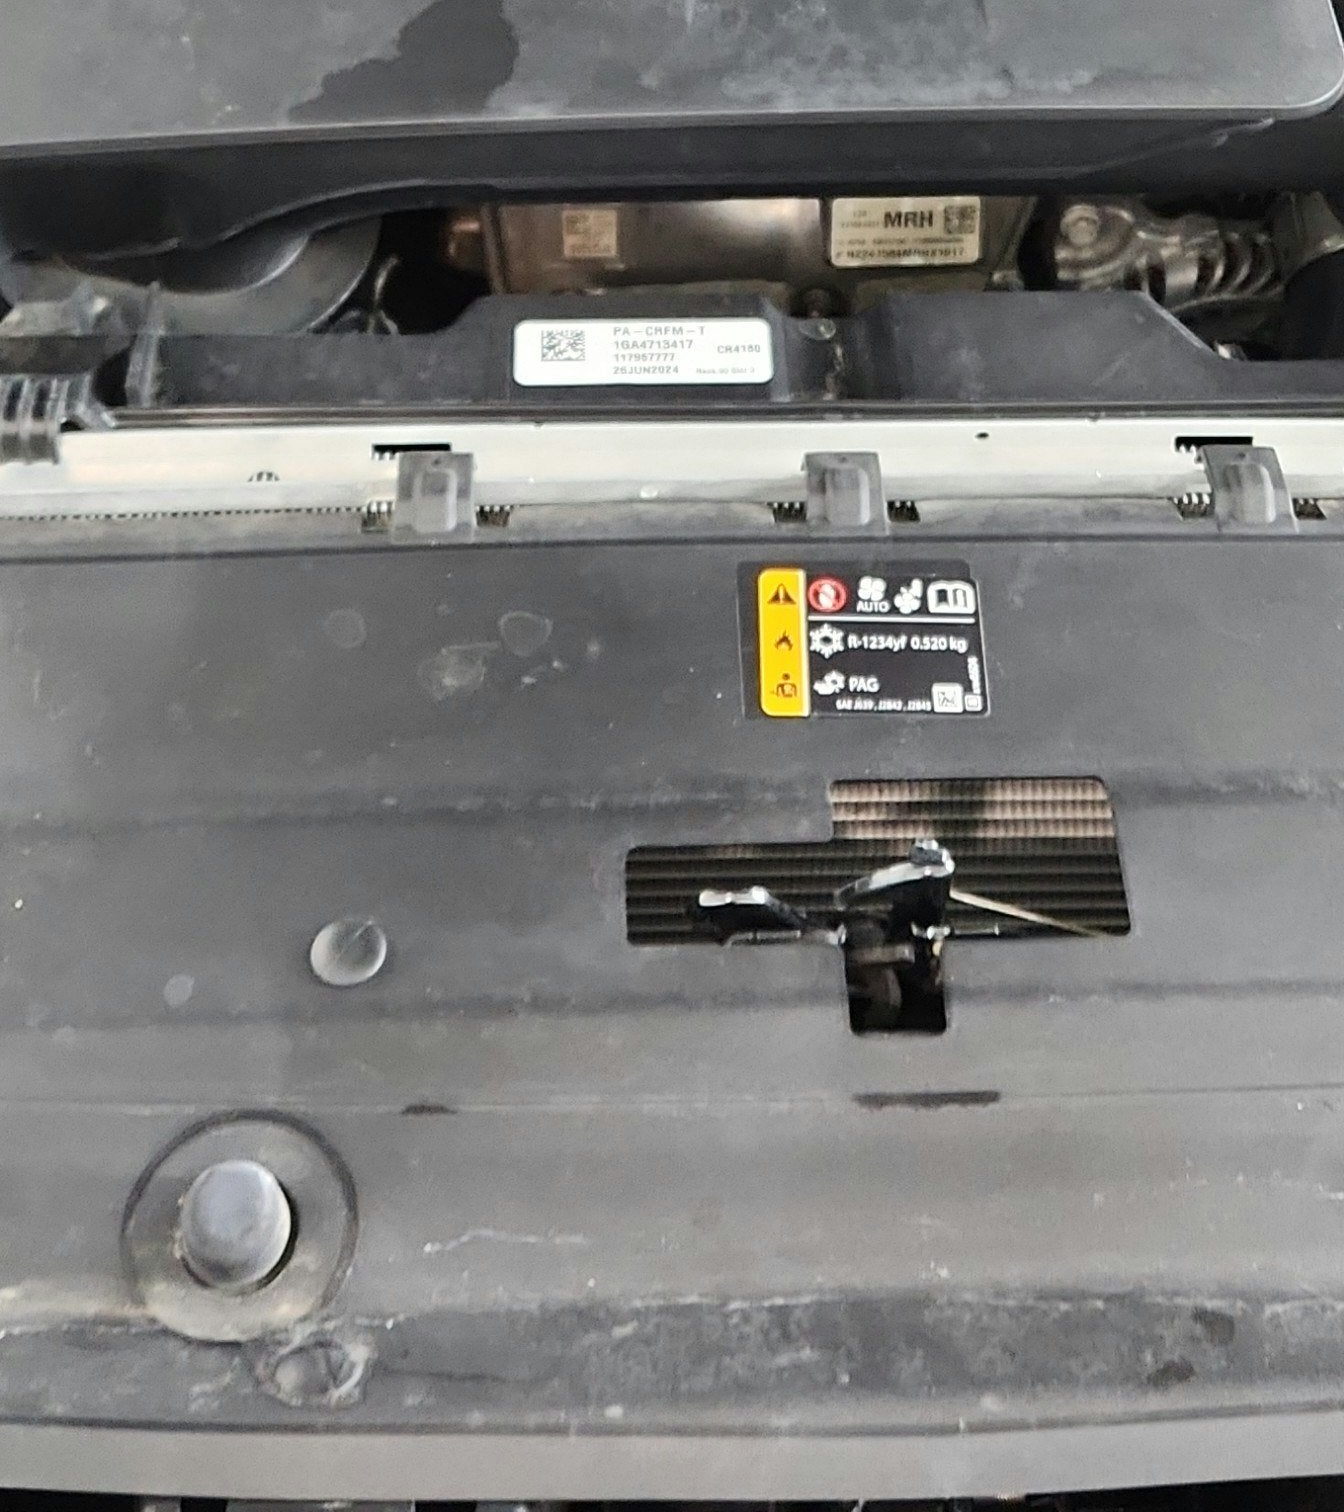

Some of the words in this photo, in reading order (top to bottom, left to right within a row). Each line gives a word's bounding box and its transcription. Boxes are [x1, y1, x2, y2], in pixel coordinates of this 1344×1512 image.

[884, 210, 933, 228] MRH
[856, 600, 890, 613] AUTO
[847, 635, 906, 652] R-1234yf
[911, 636, 948, 651] 0.520
[949, 636, 968, 654] kg
[848, 676, 880, 693] PAG
